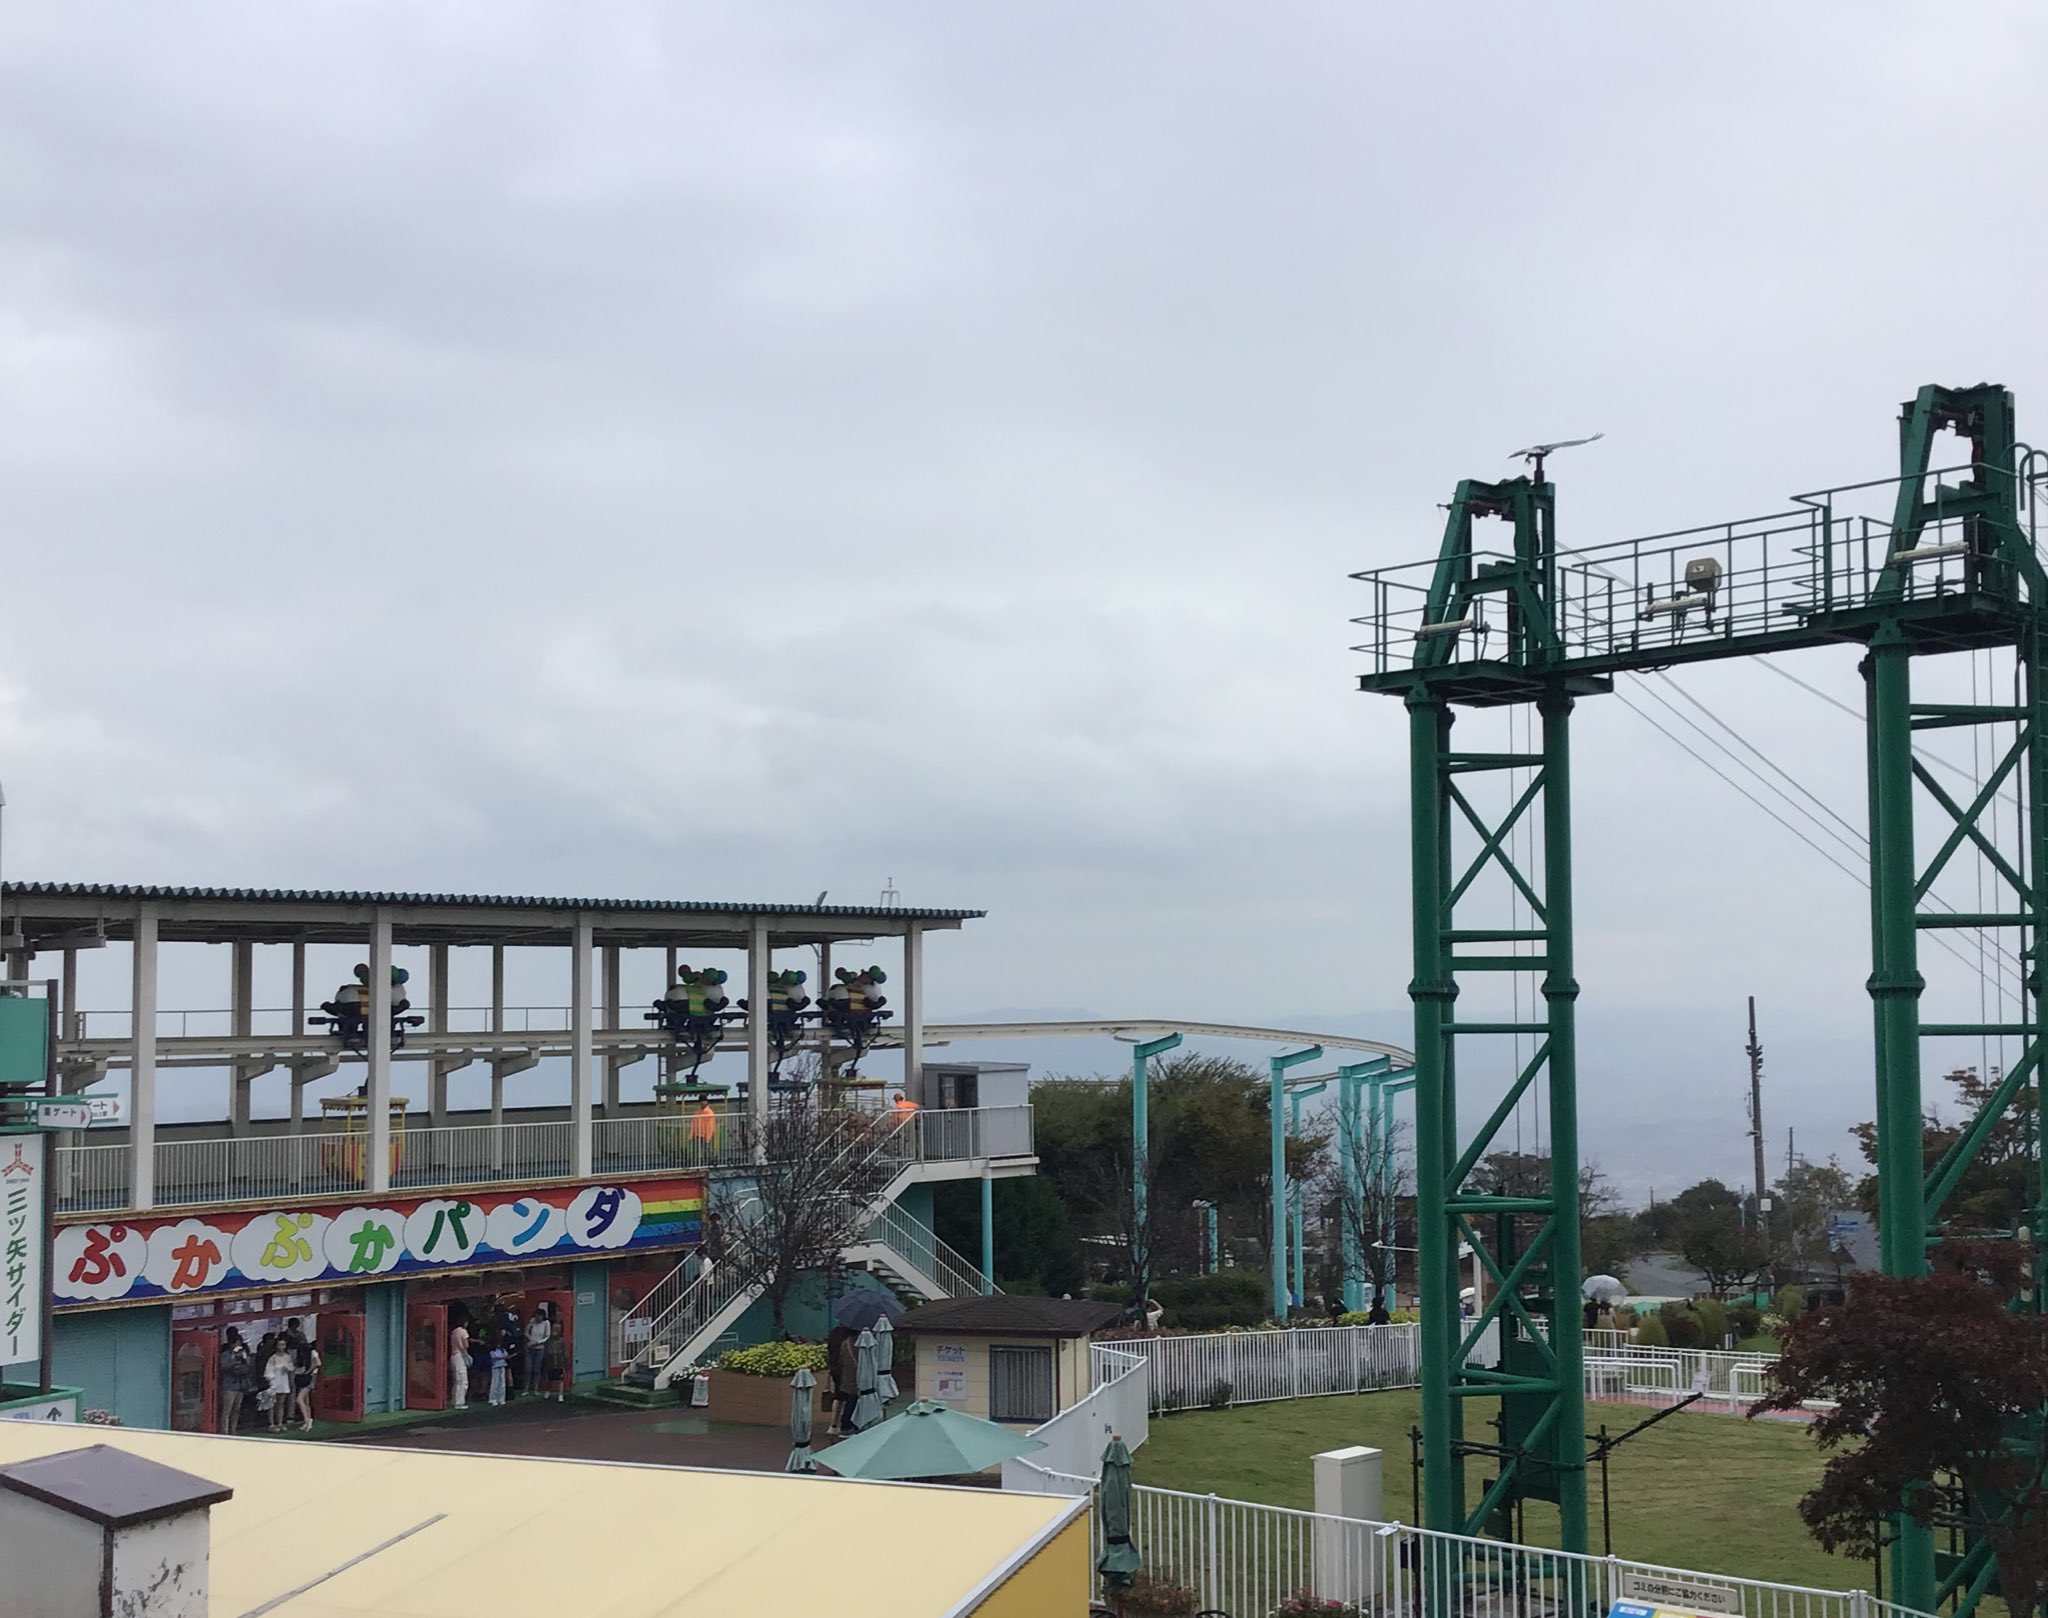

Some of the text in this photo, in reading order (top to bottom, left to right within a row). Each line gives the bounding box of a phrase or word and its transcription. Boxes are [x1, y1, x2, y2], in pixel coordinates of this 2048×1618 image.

[6, 1188, 28, 1357] 三ツ矢サイダー
[68, 1186, 626, 1290] ぷかぷかパンダ
